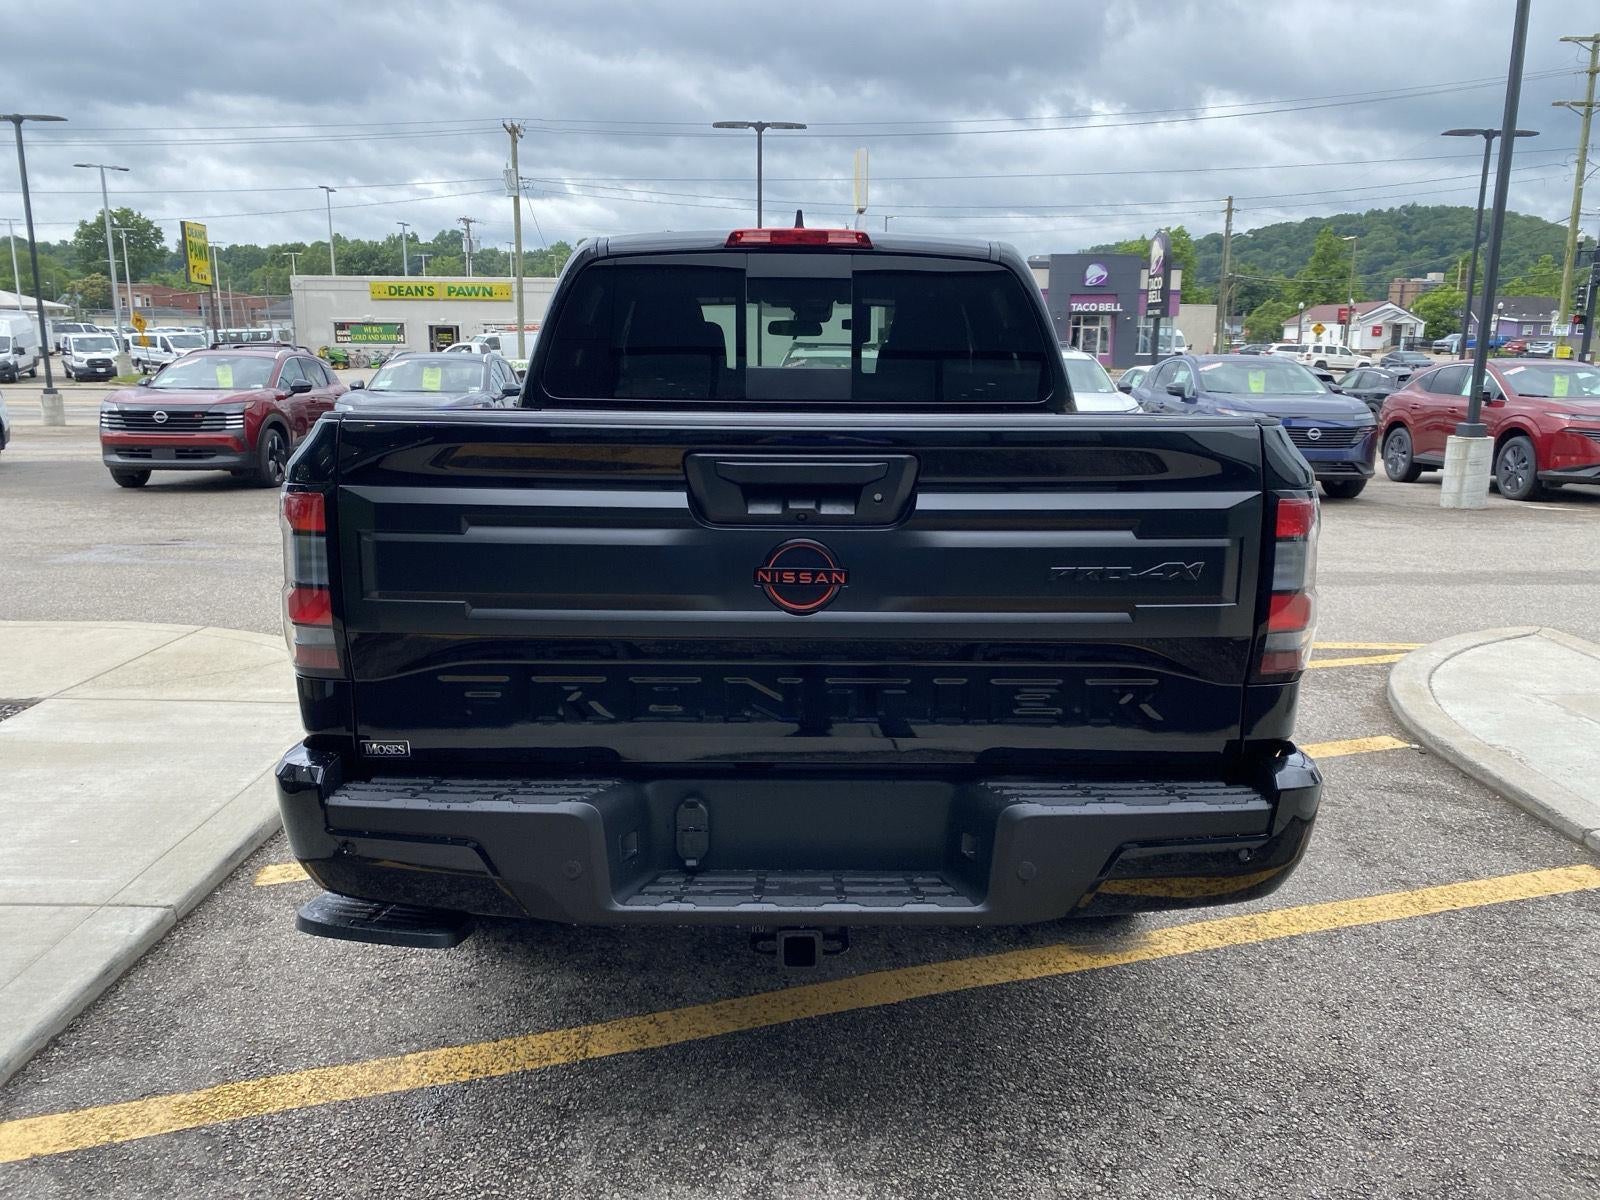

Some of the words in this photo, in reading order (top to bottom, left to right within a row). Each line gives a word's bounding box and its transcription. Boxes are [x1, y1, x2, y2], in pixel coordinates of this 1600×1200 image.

[189, 240, 208, 262] PAWN
[1149, 277, 1163, 290] TACO
[388, 285, 434, 297] DEAN'S
[447, 285, 494, 297] PAWN
[1148, 291, 1162, 303] BELL
[1071, 303, 1097, 311] TACO
[1098, 303, 1123, 311] BELL
[757, 570, 845, 584] NISSAN
[436, 675, 1164, 722] FRONTIER
[365, 743, 406, 755] MOSES
